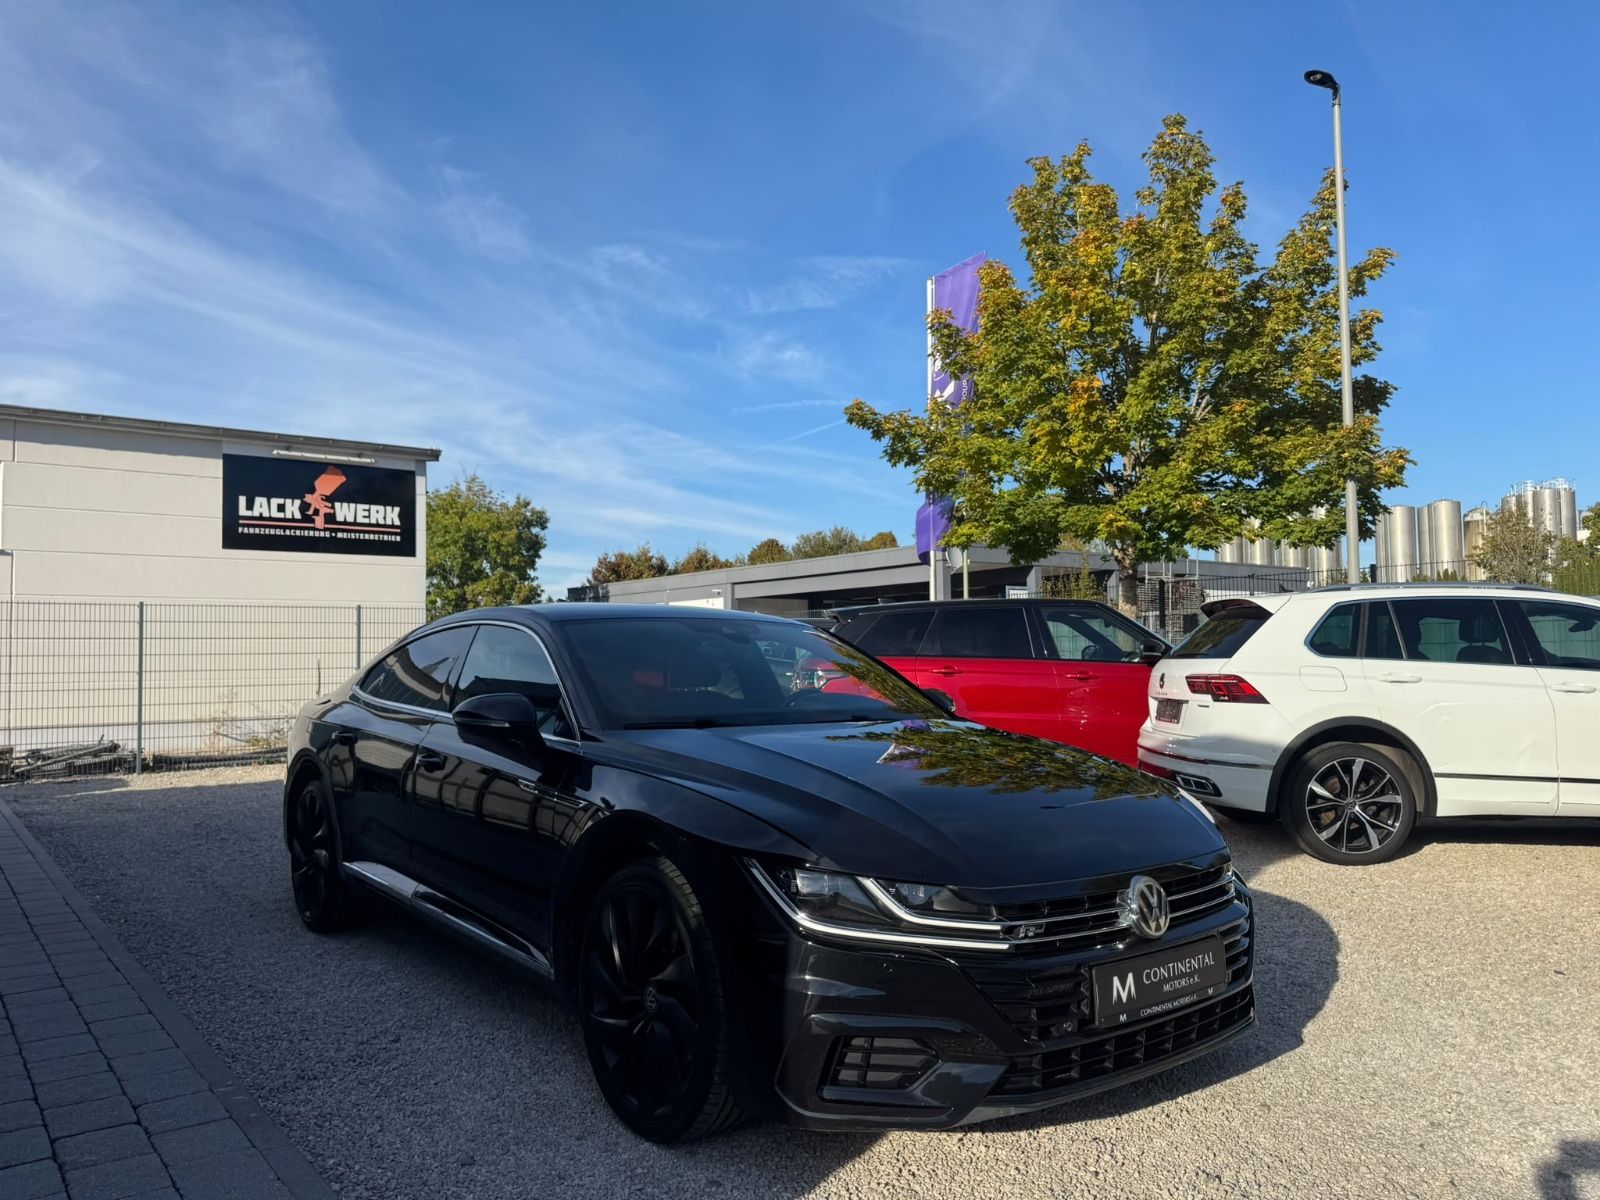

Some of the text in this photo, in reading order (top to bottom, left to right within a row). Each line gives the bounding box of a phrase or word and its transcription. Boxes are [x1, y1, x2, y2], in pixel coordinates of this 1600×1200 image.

[238, 495, 401, 526] LACK WERK
[238, 527, 401, 542] FAHRZEUGLACKIERUNG MEISTERBETRIEB
[1143, 952, 1215, 984] CONTINENTAL
[1112, 972, 1136, 1005] M
[1163, 977, 1190, 993] MOTORS
